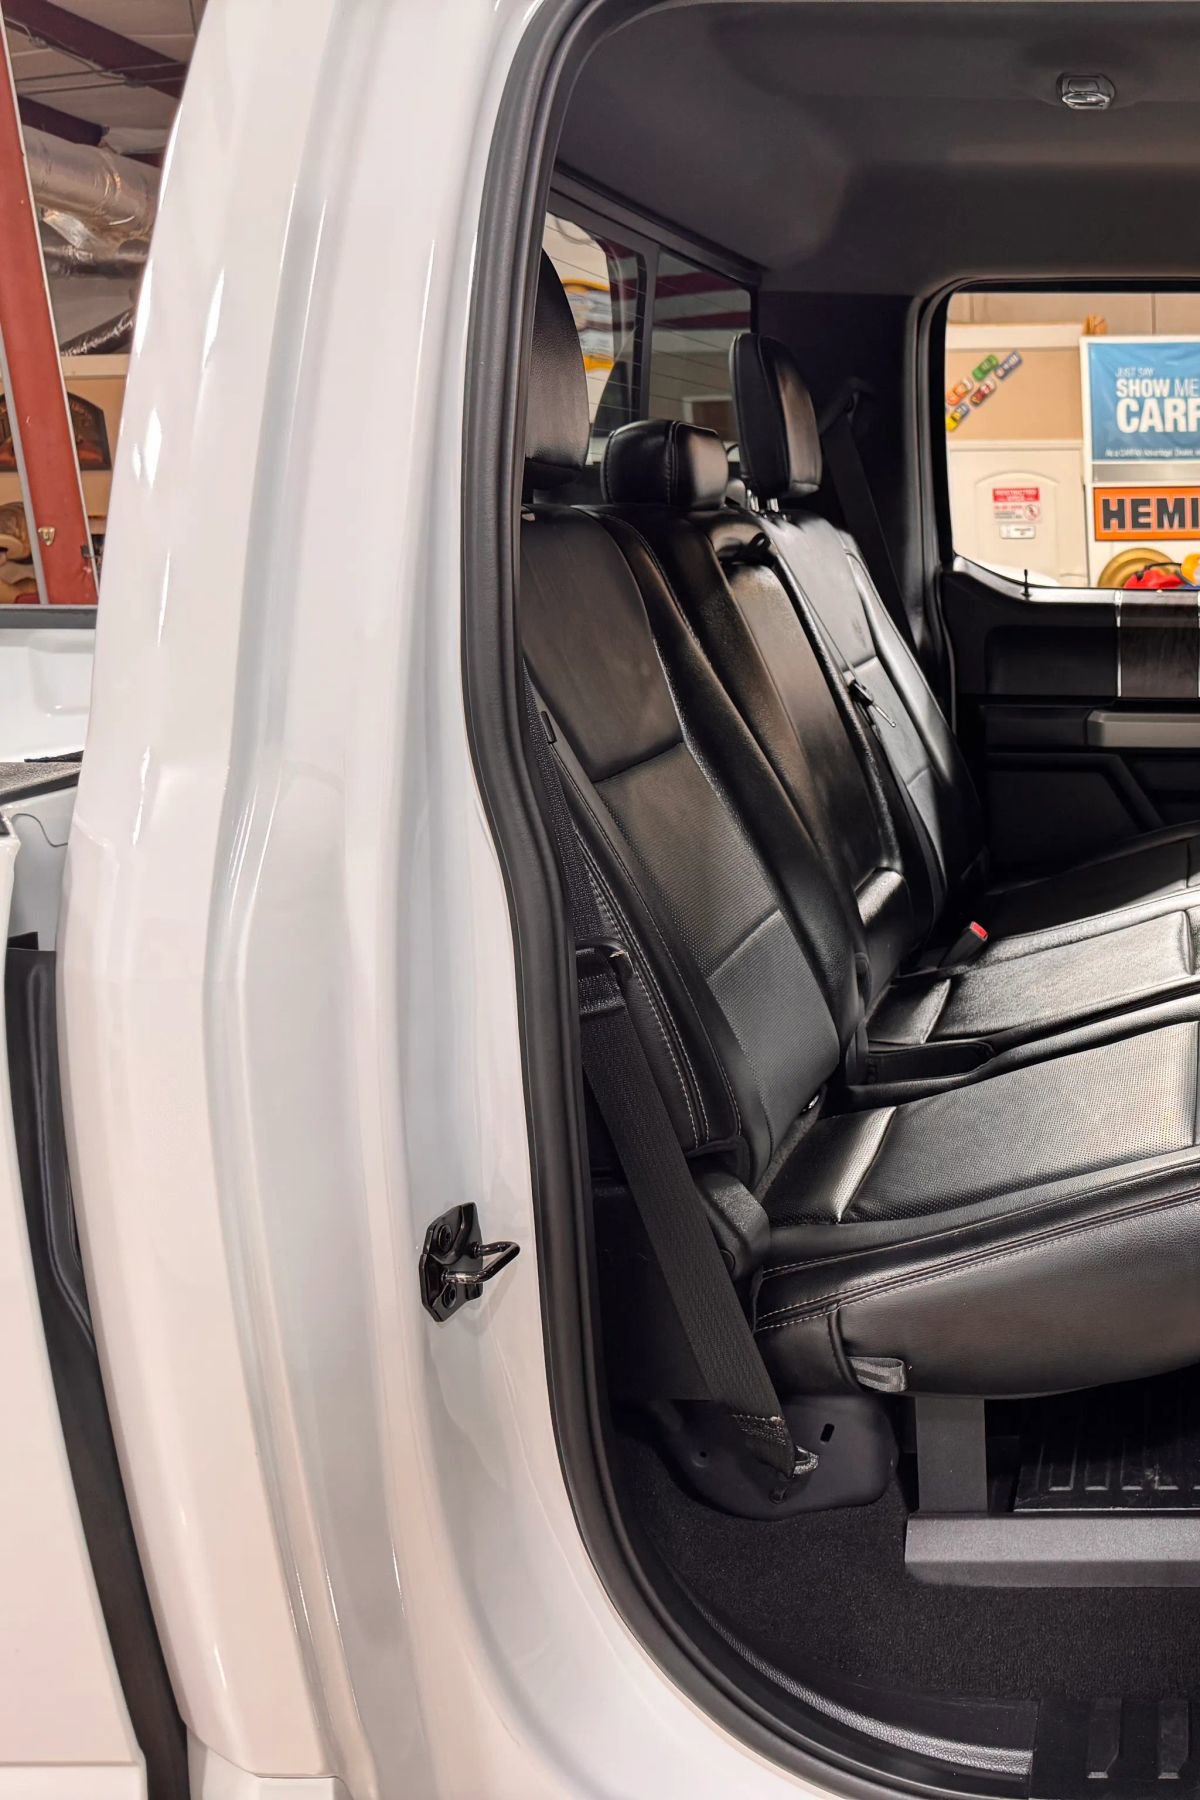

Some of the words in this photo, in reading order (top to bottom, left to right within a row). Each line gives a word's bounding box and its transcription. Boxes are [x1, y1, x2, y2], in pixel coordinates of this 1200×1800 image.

[1116, 378, 1171, 397] SHOW
[1174, 378, 1199, 396] ME
[1102, 497, 1200, 531] HEMI
